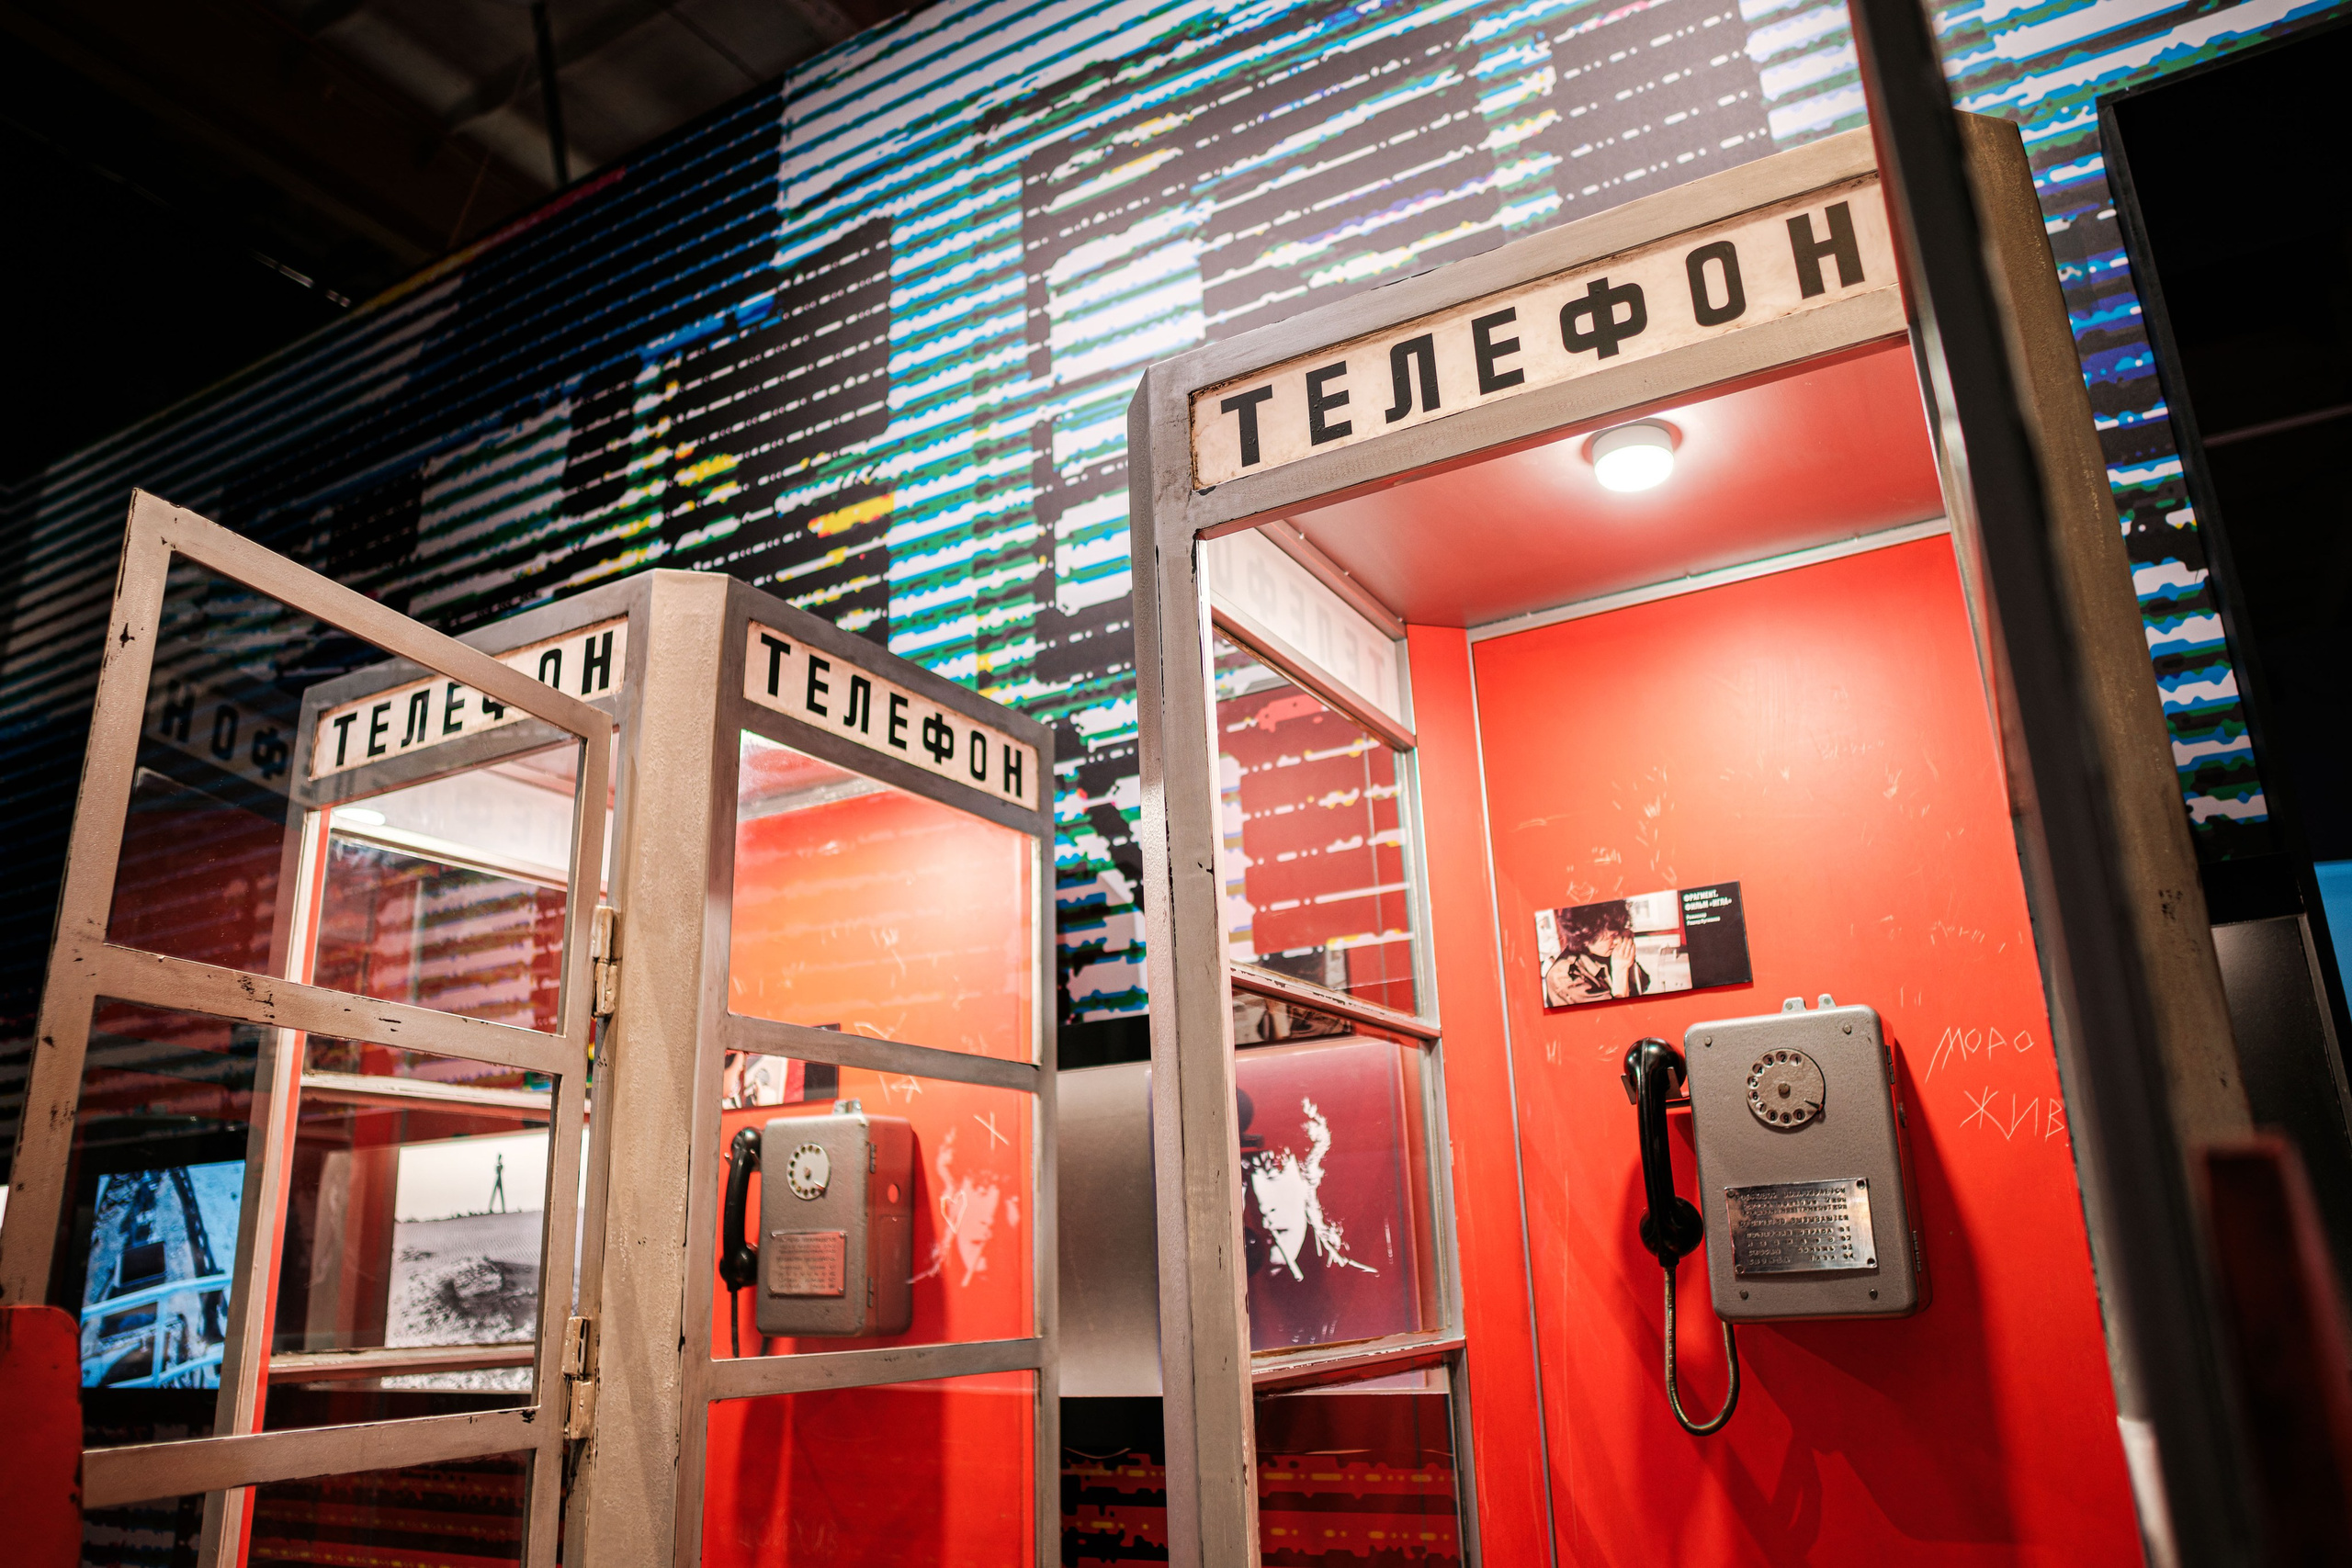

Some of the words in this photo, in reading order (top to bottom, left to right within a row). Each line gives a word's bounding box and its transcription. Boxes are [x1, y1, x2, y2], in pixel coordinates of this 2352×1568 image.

[1220, 200, 1865, 468] ТЕЛЕФОН
[761, 632, 1023, 798] ТЕЛЕФОН
[1842, 1251, 1854, 1259] 04
